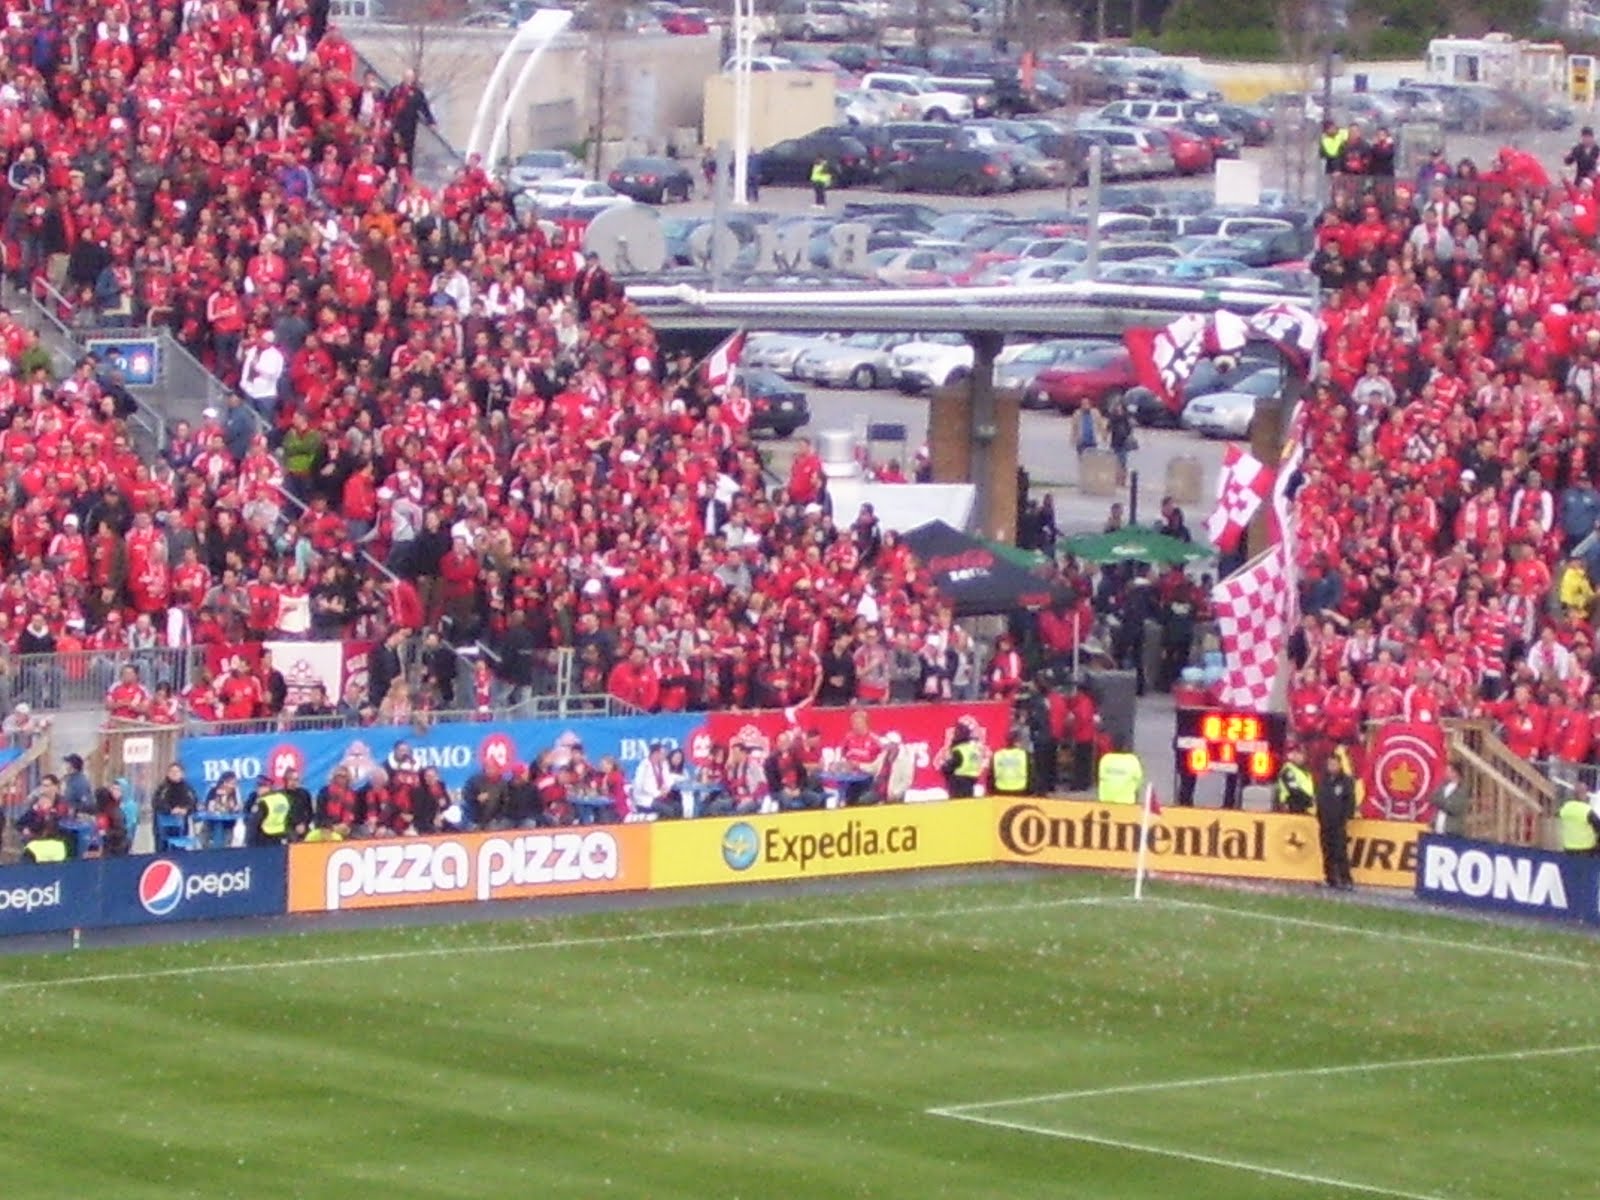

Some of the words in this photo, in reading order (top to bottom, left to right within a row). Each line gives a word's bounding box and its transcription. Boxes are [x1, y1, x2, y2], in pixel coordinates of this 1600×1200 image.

[203, 757, 261, 782] BMO
[764, 820, 918, 871] Expedia.ca
[998, 804, 1267, 862] Continental
[1344, 836, 1418, 871] IRE
[185, 866, 252, 900] pepsi
[1424, 845, 1568, 909] RONA
